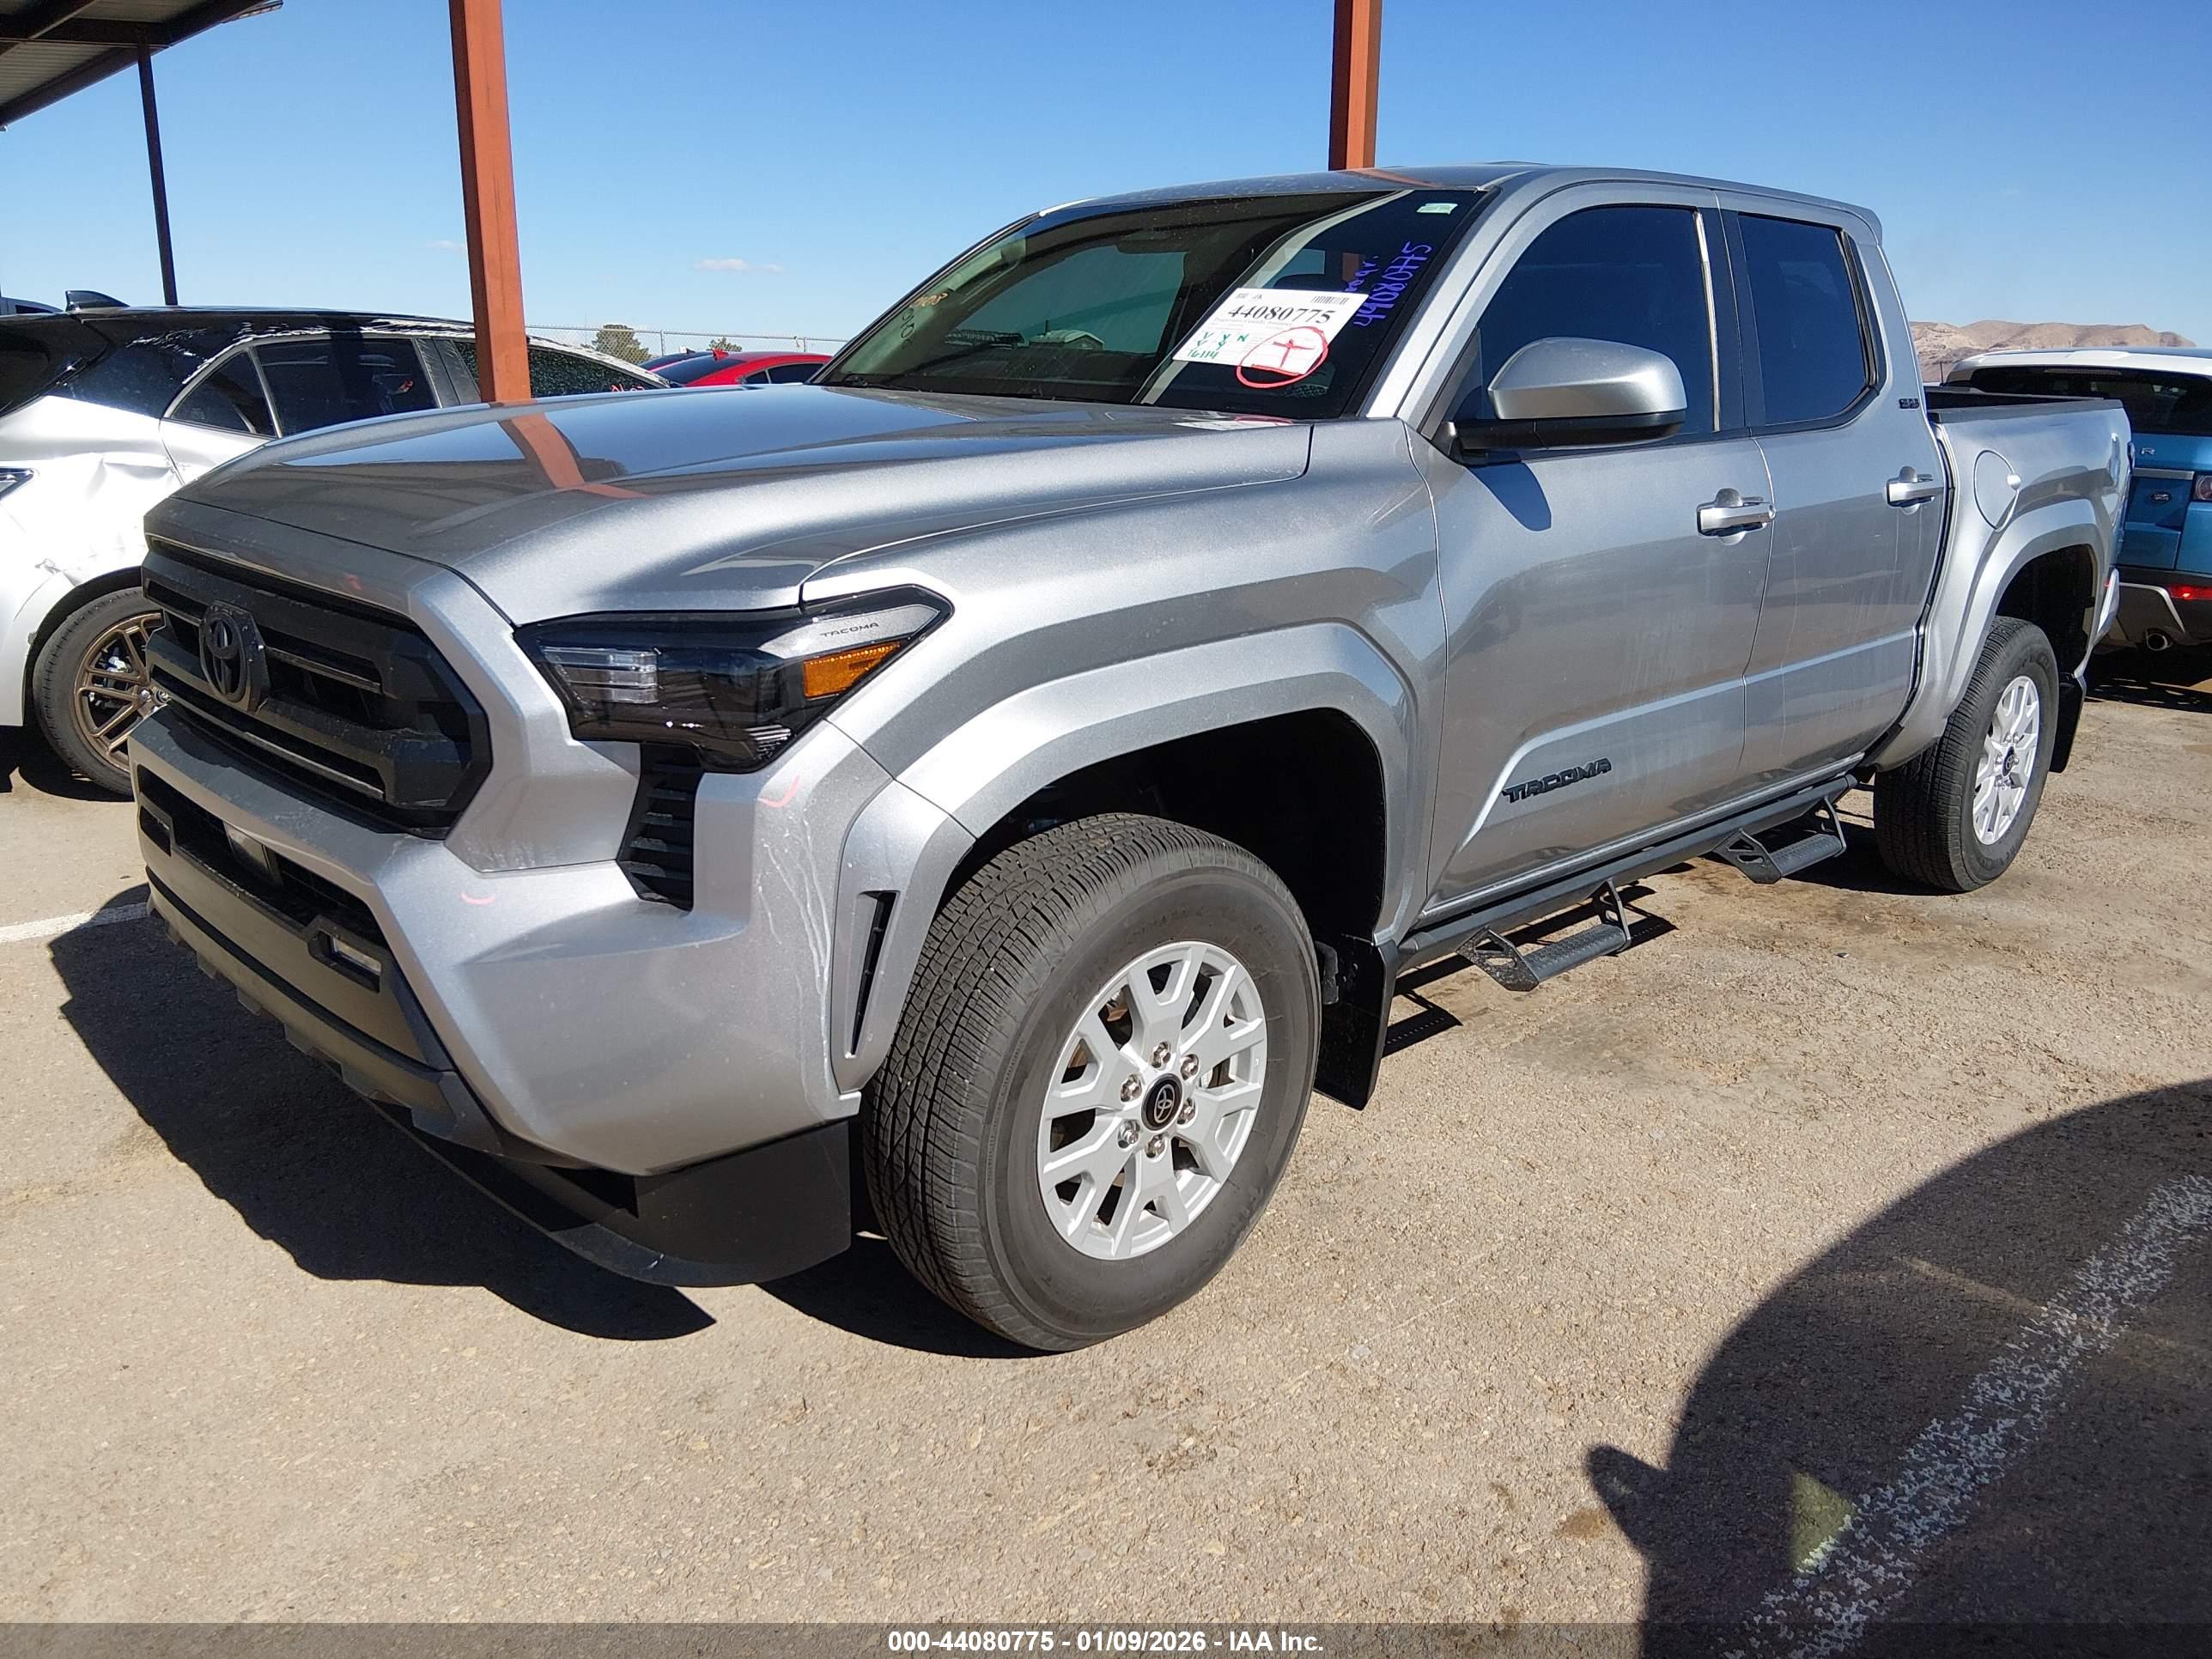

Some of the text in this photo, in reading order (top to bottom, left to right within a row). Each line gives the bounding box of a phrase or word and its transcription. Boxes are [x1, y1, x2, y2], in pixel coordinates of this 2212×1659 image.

[1228, 305, 1336, 324] 44080775
[820, 623, 879, 637] TACOMA
[1502, 757, 1613, 804] TACOMA
